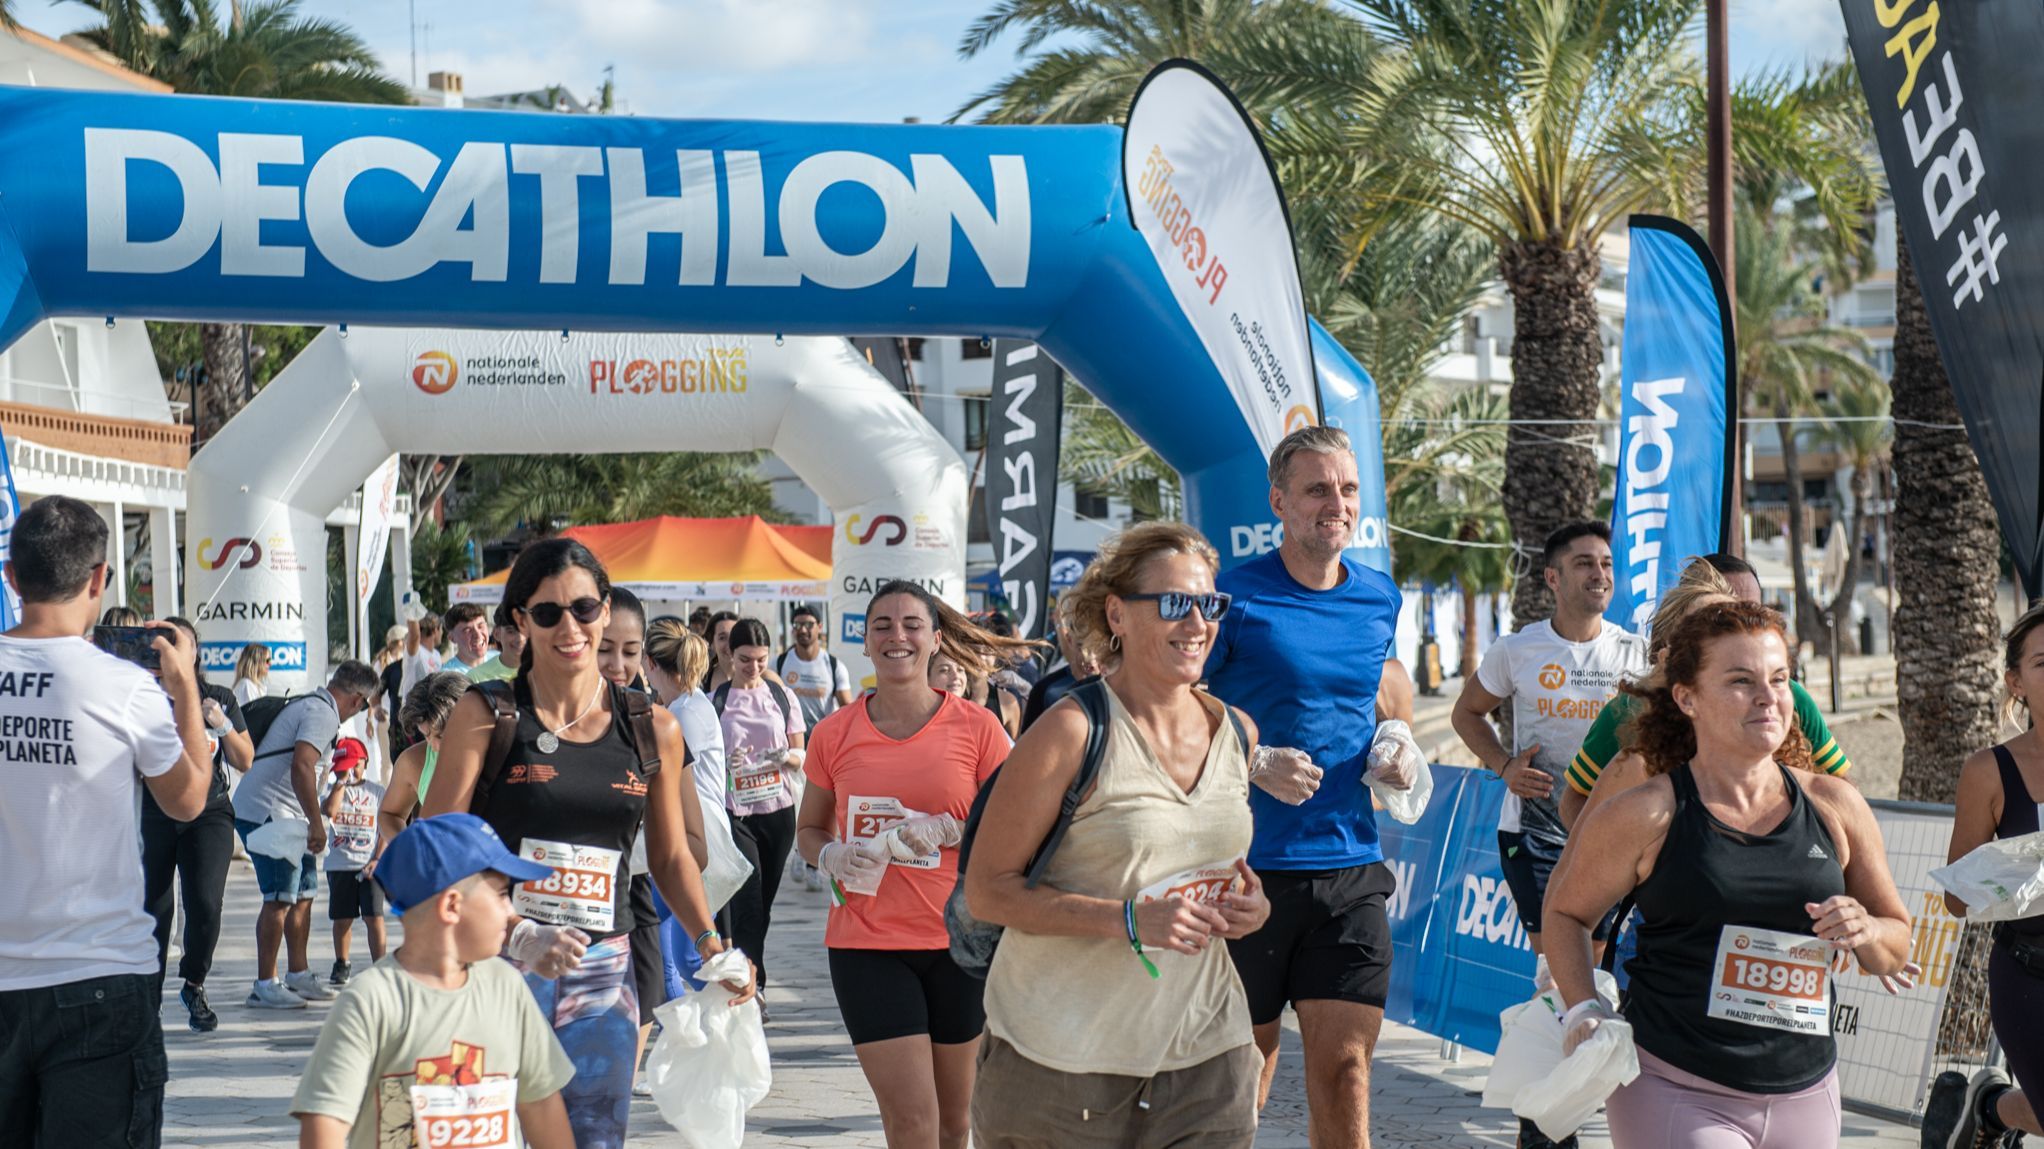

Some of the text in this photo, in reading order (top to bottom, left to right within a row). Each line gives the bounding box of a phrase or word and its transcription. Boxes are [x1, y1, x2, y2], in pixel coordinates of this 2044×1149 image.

[84, 126, 1031, 289] DECATHLON
[467, 356, 540, 369] nationale
[467, 371, 565, 386] nederlanden
[590, 358, 746, 394] PLOGGING
[1231, 517, 1388, 557] DECLON
[196, 602, 303, 620] GARMIN
[0, 671, 54, 698] AFF
[1571, 669, 1613, 678] nationale
[0, 715, 74, 741] EPORTE
[740, 772, 776, 789] 21196
[1734, 959, 1819, 996] 18998
[1834, 1003, 1859, 1036] ETA
